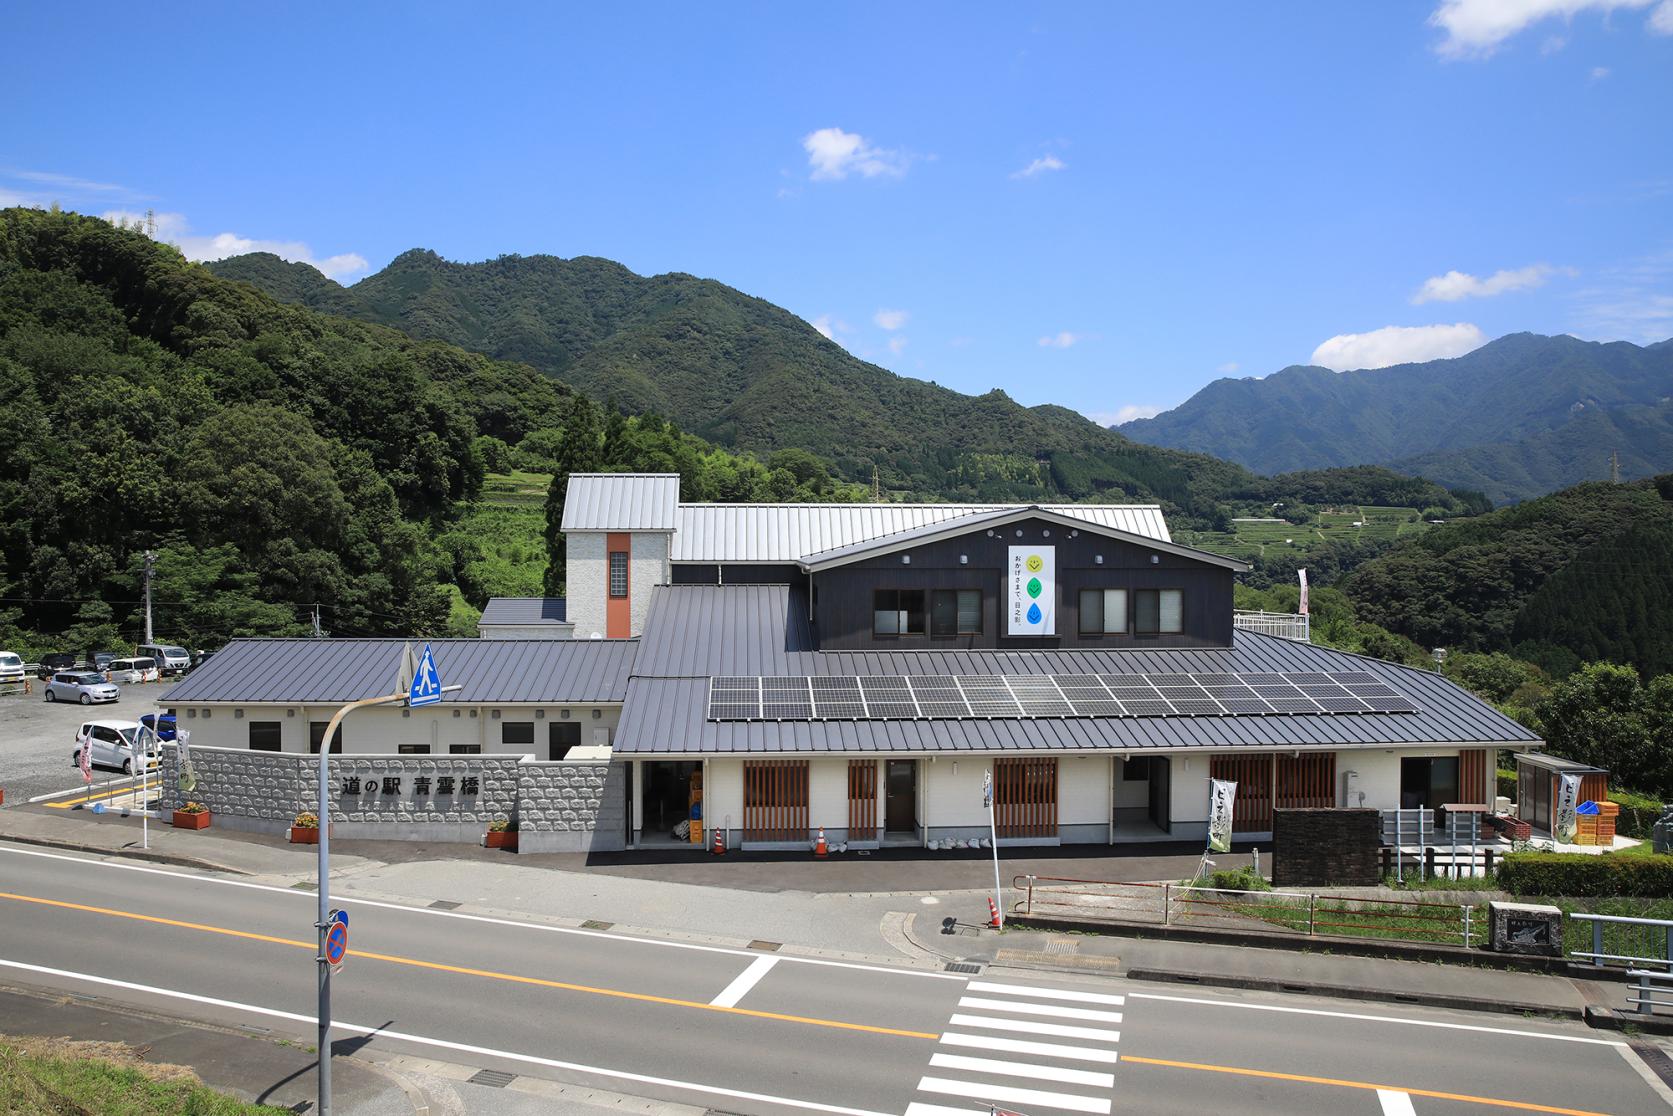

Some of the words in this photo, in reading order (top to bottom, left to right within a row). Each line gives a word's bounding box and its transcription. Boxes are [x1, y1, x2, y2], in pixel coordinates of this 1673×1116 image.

[342, 776, 401, 795] 道の駅
[414, 776, 479, 795] 青雲橋
